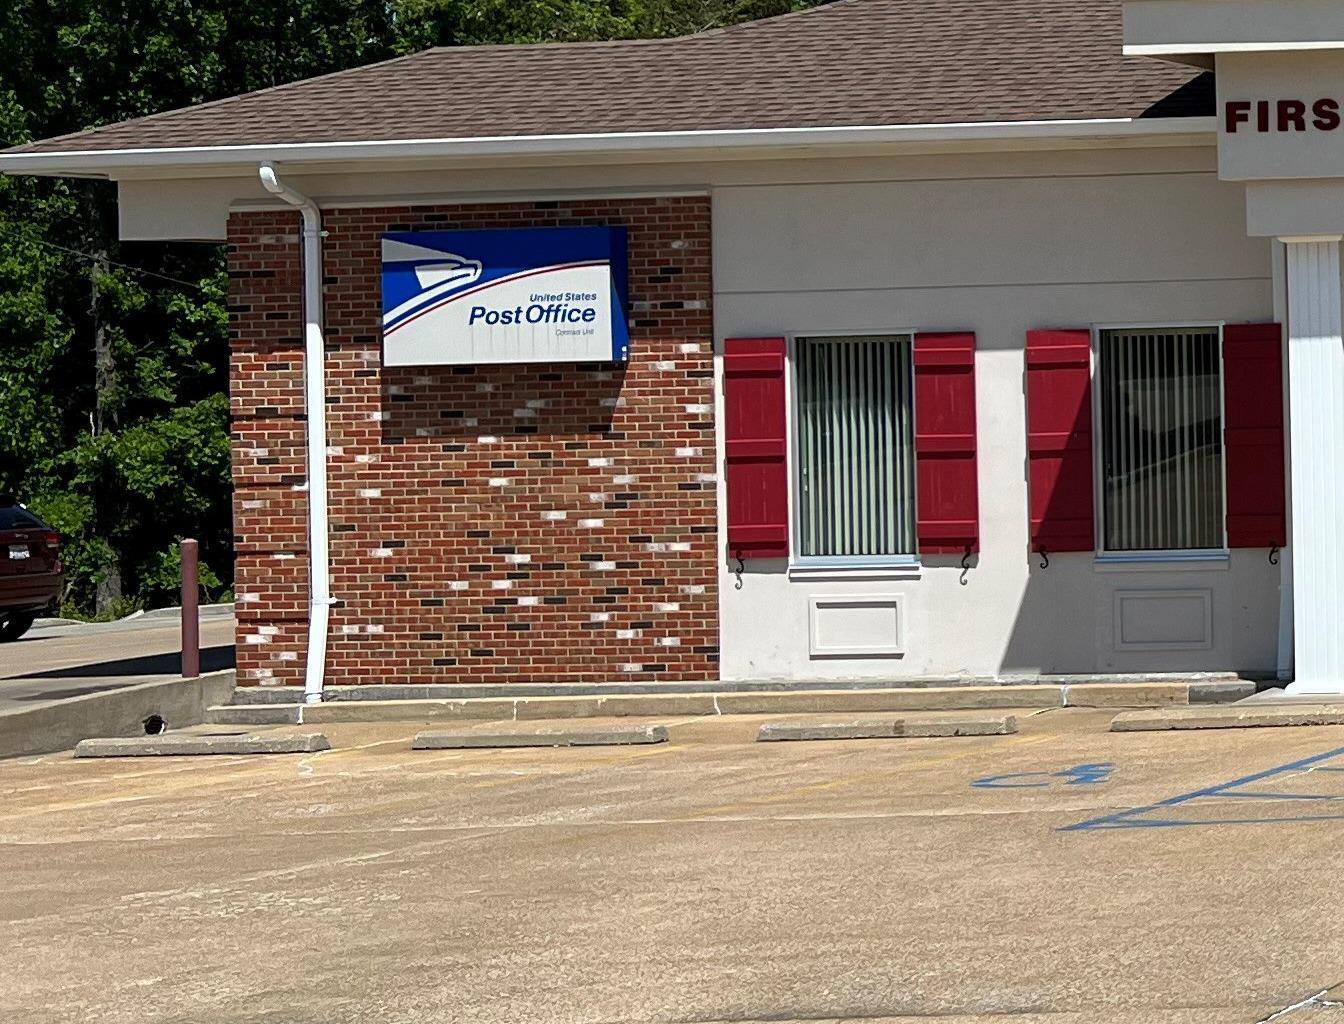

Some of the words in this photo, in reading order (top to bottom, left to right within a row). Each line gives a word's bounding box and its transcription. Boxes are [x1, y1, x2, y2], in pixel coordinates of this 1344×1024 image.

[529, 293, 564, 302] United
[565, 292, 597, 301] States
[469, 306, 523, 325] Post
[525, 303, 596, 323] Office
